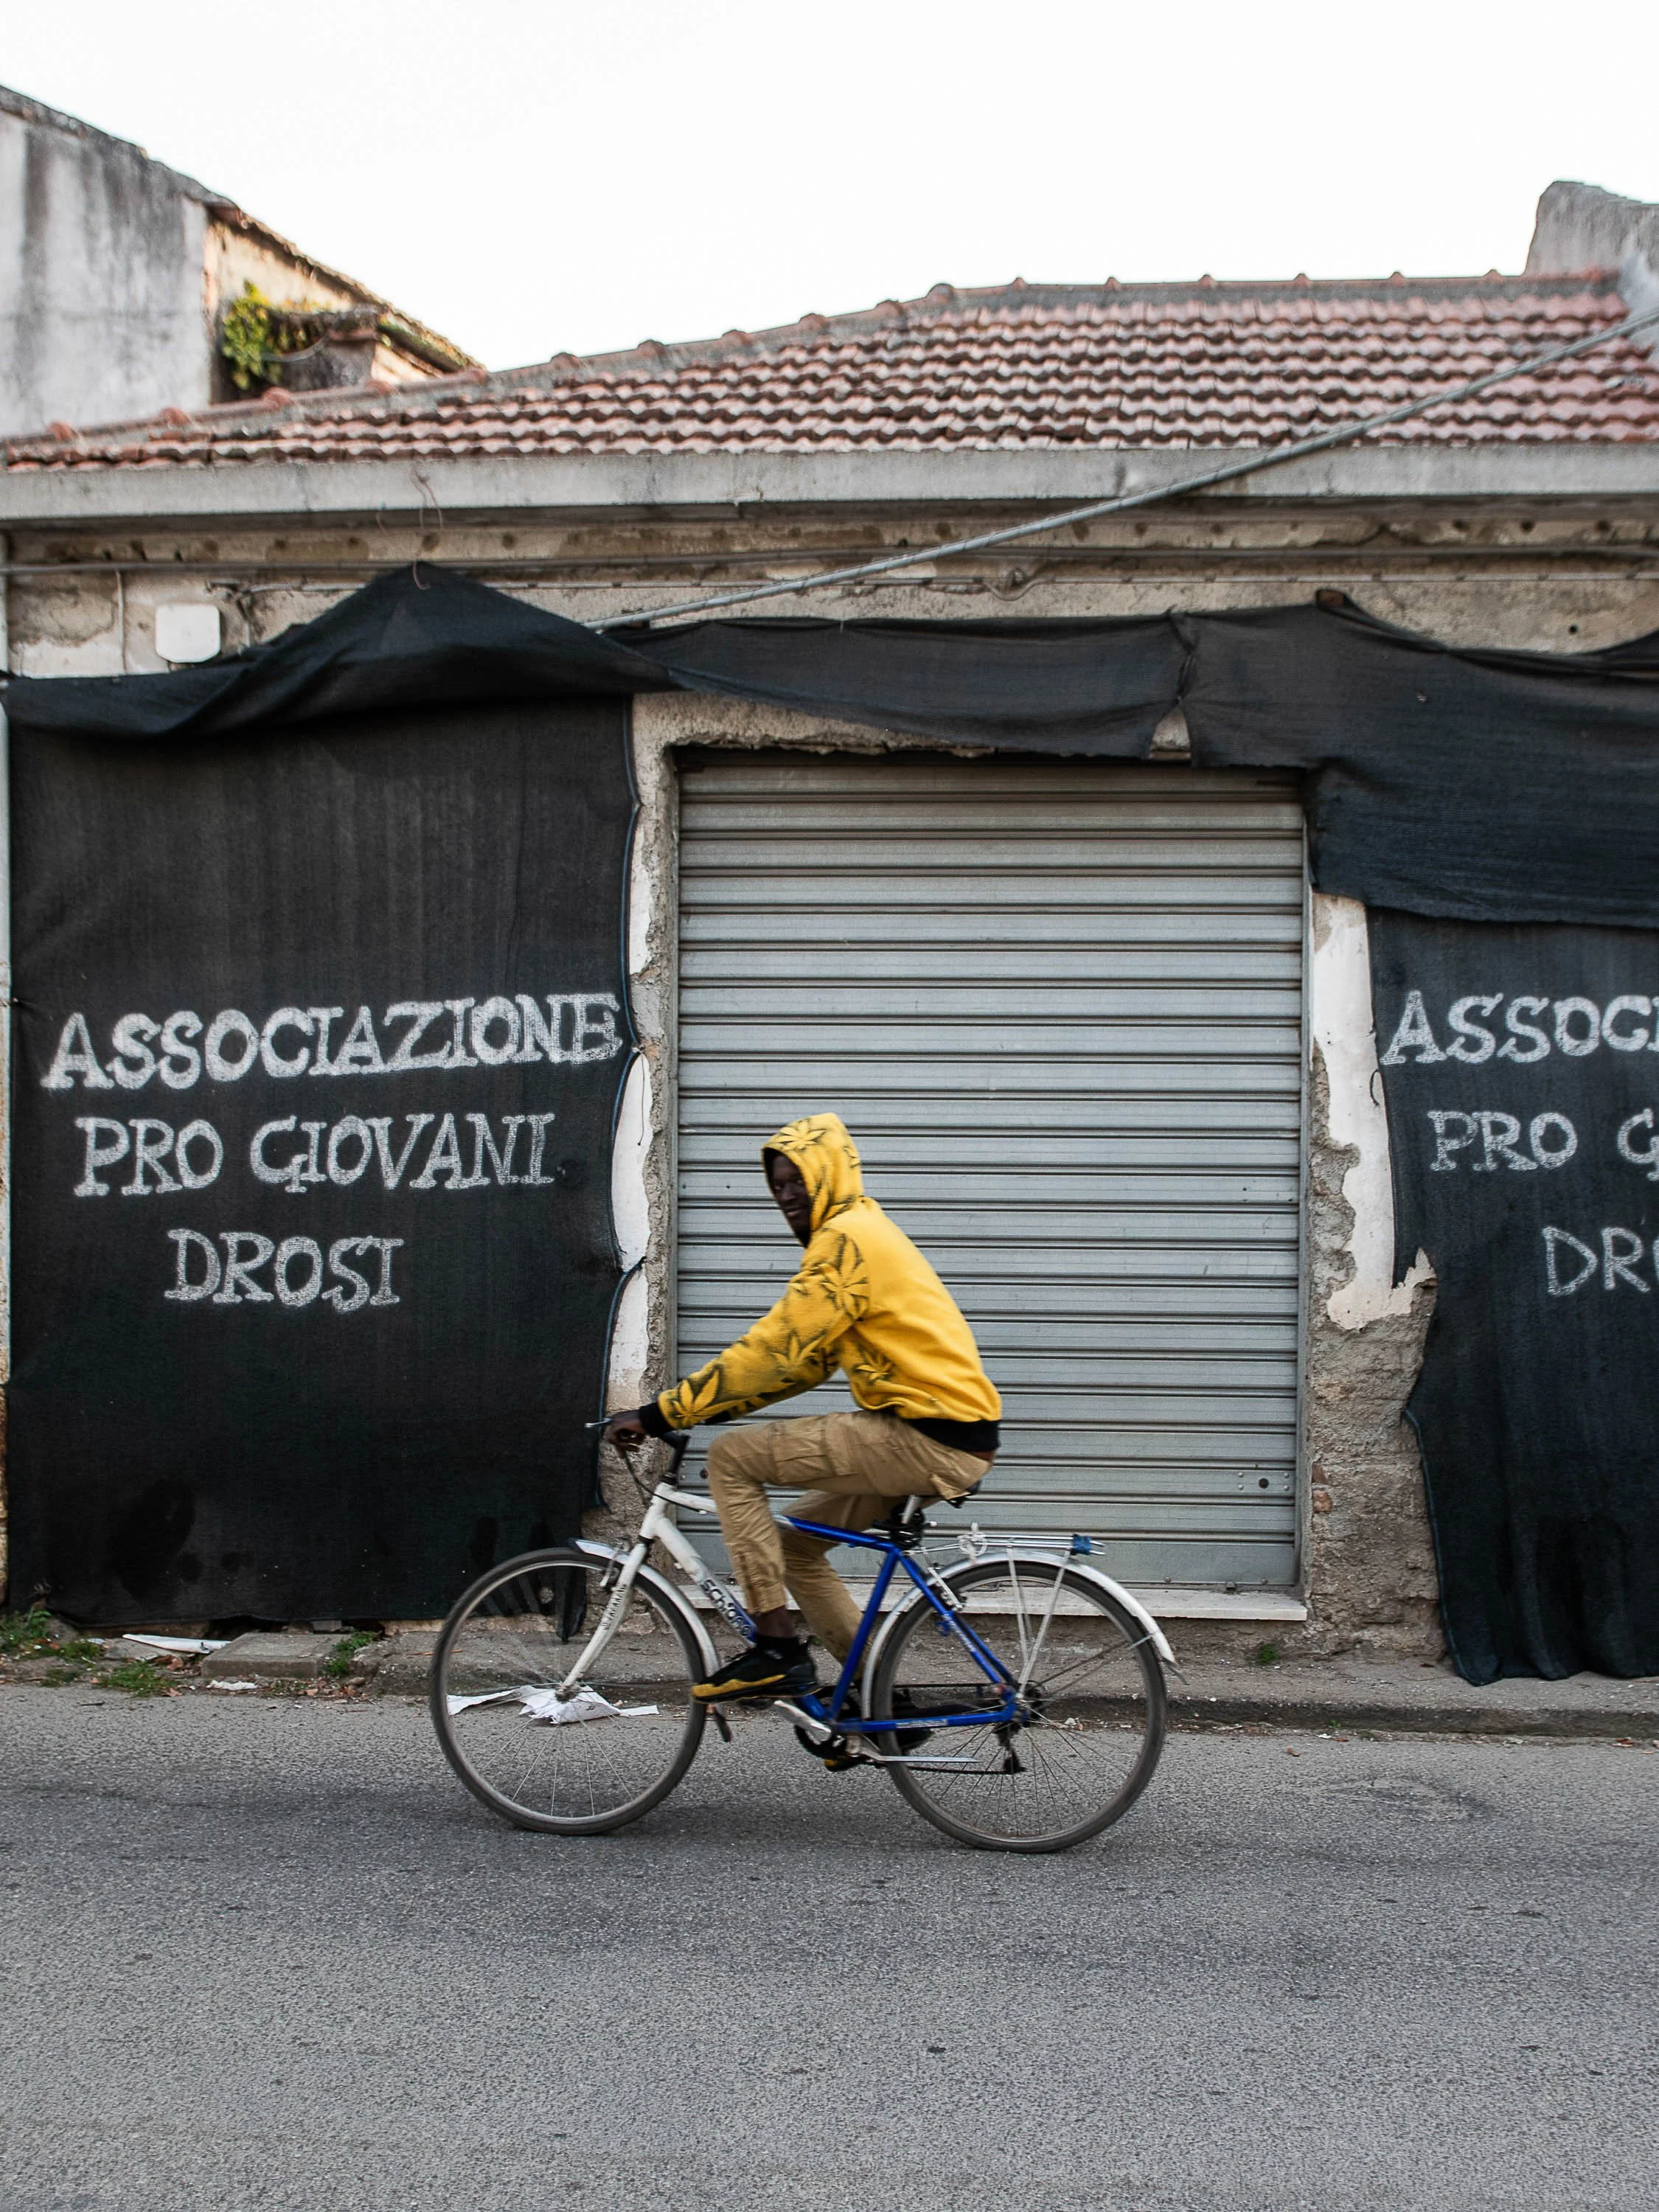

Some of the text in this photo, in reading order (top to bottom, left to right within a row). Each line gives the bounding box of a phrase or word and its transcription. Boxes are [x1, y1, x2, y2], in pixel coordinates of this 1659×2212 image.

[41, 992, 624, 1091] ASSOCIAZIONE
[74, 1113, 555, 1197] PRO GIOVANI
[1427, 1110, 1579, 1172] PRO
[164, 1228, 404, 1312] DROSI
[1542, 1225, 1659, 1295] DR
